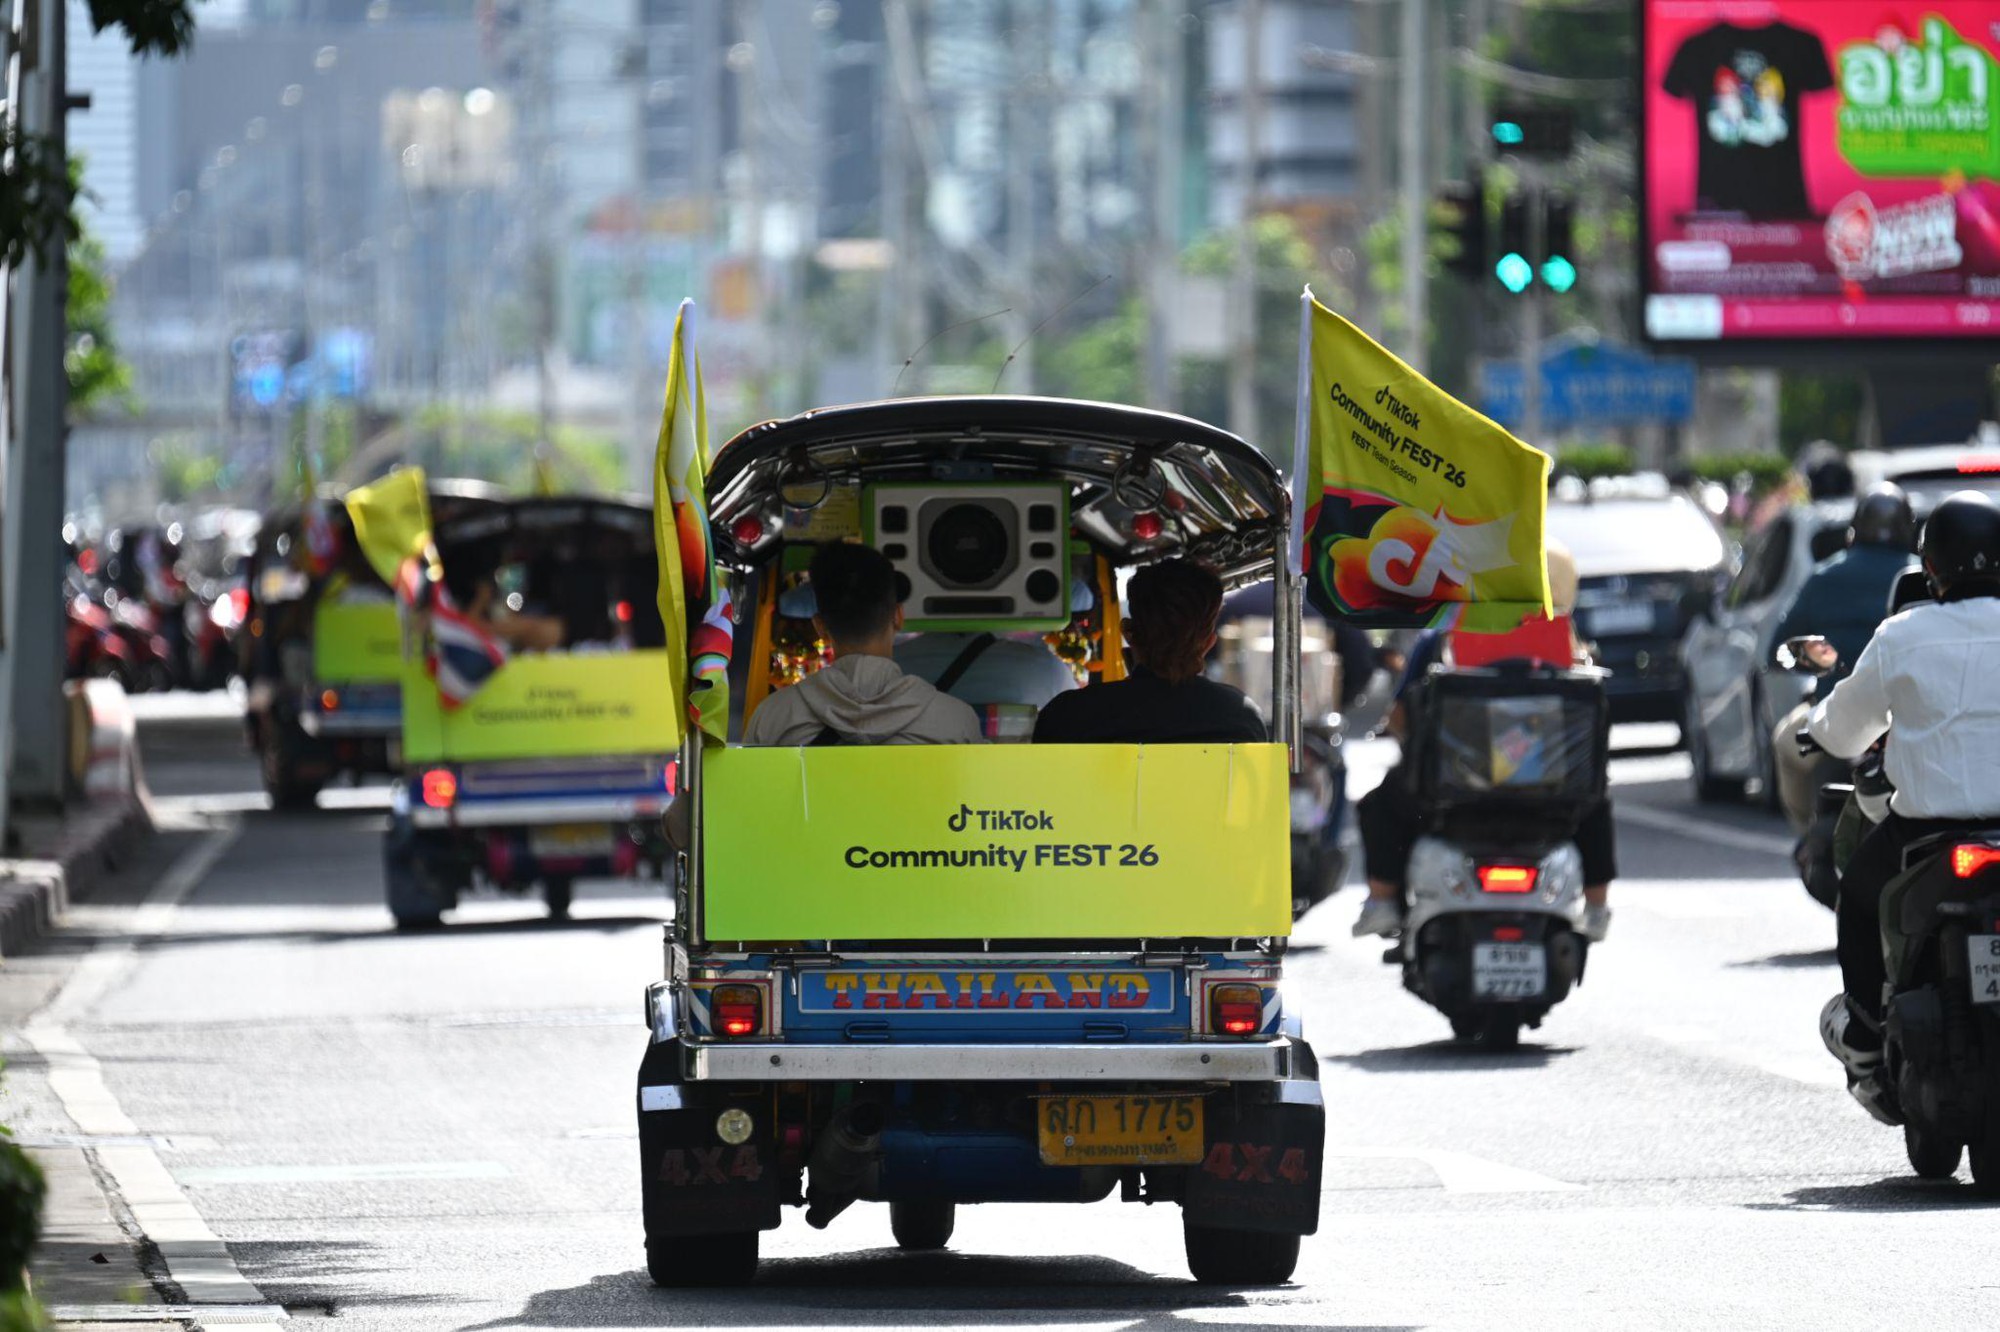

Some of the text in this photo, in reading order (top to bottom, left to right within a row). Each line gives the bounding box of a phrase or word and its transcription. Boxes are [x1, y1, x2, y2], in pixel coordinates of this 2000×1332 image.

[1840, 17, 1989, 106] อย่า
[1386, 394, 1421, 430] TikTok
[1330, 382, 1467, 488] Community FEST 26
[1351, 430, 1418, 486] FEST Team Season
[976, 810, 1054, 831] TikTok
[844, 843, 1160, 873] Community FEST 26
[824, 972, 1151, 1009] THAILAND
[1114, 1099, 1195, 1134] 1775
